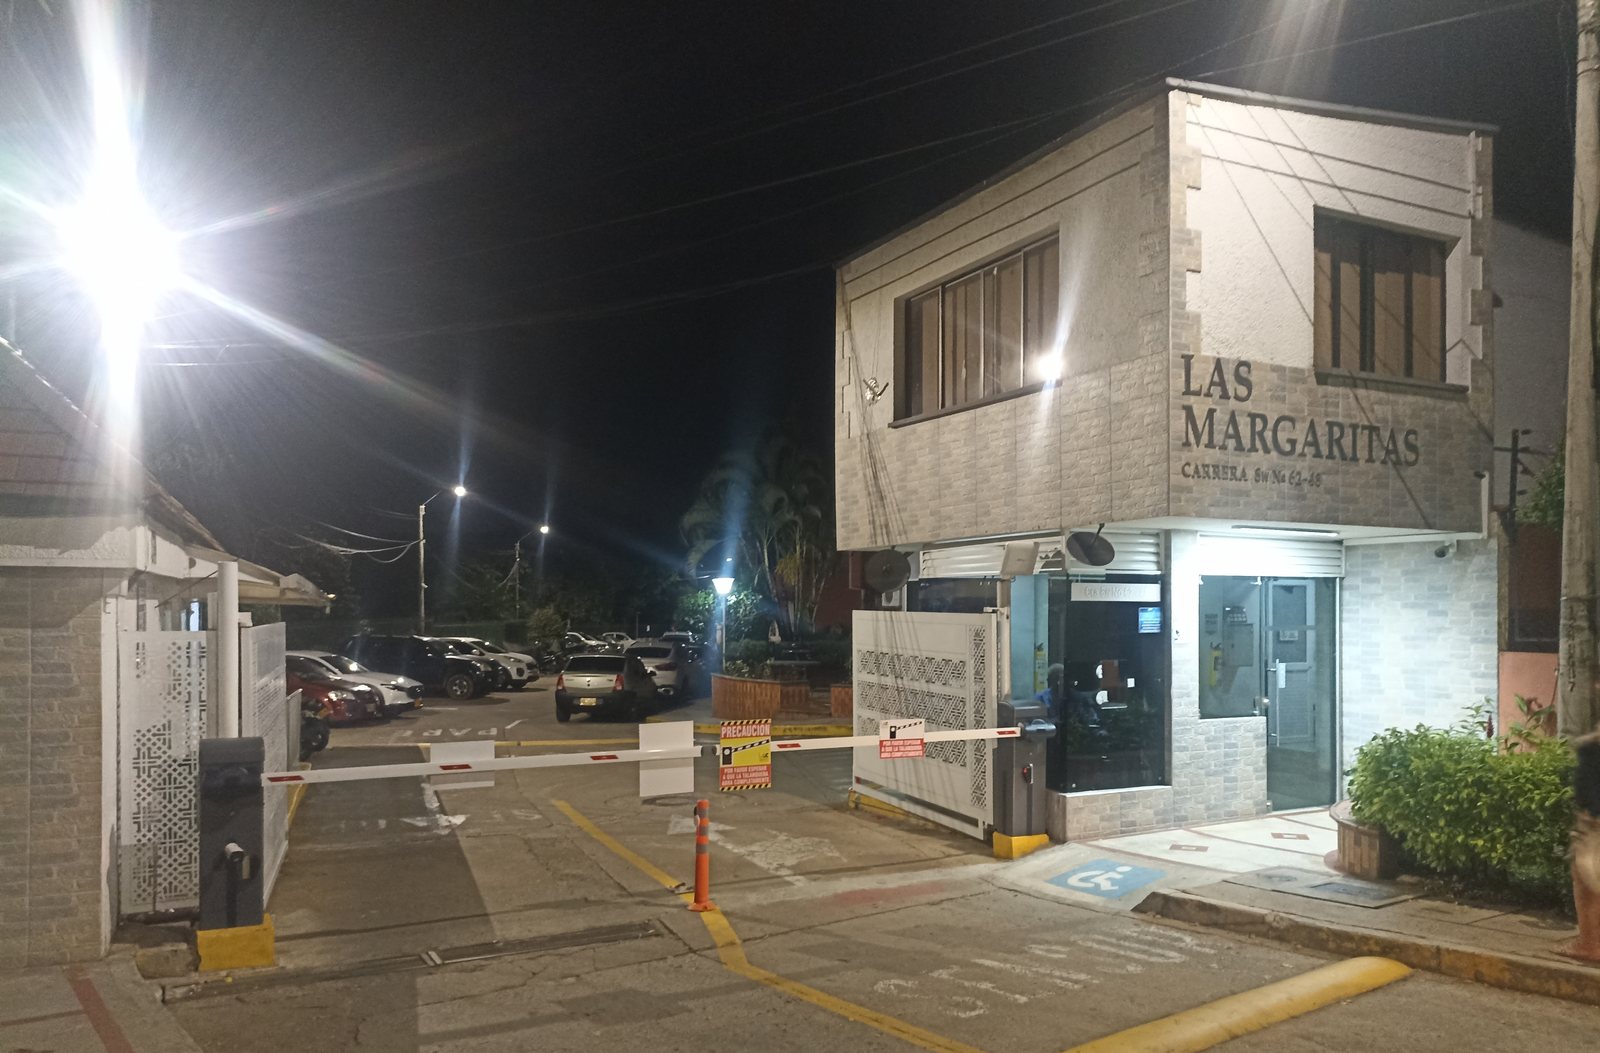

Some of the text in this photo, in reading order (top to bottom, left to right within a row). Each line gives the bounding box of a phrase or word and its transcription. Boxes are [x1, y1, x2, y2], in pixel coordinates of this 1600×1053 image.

[1180, 353, 1253, 403] LAS
[1181, 404, 1420, 467] MARGARITAS
[1181, 461, 1248, 482] CARRERA
